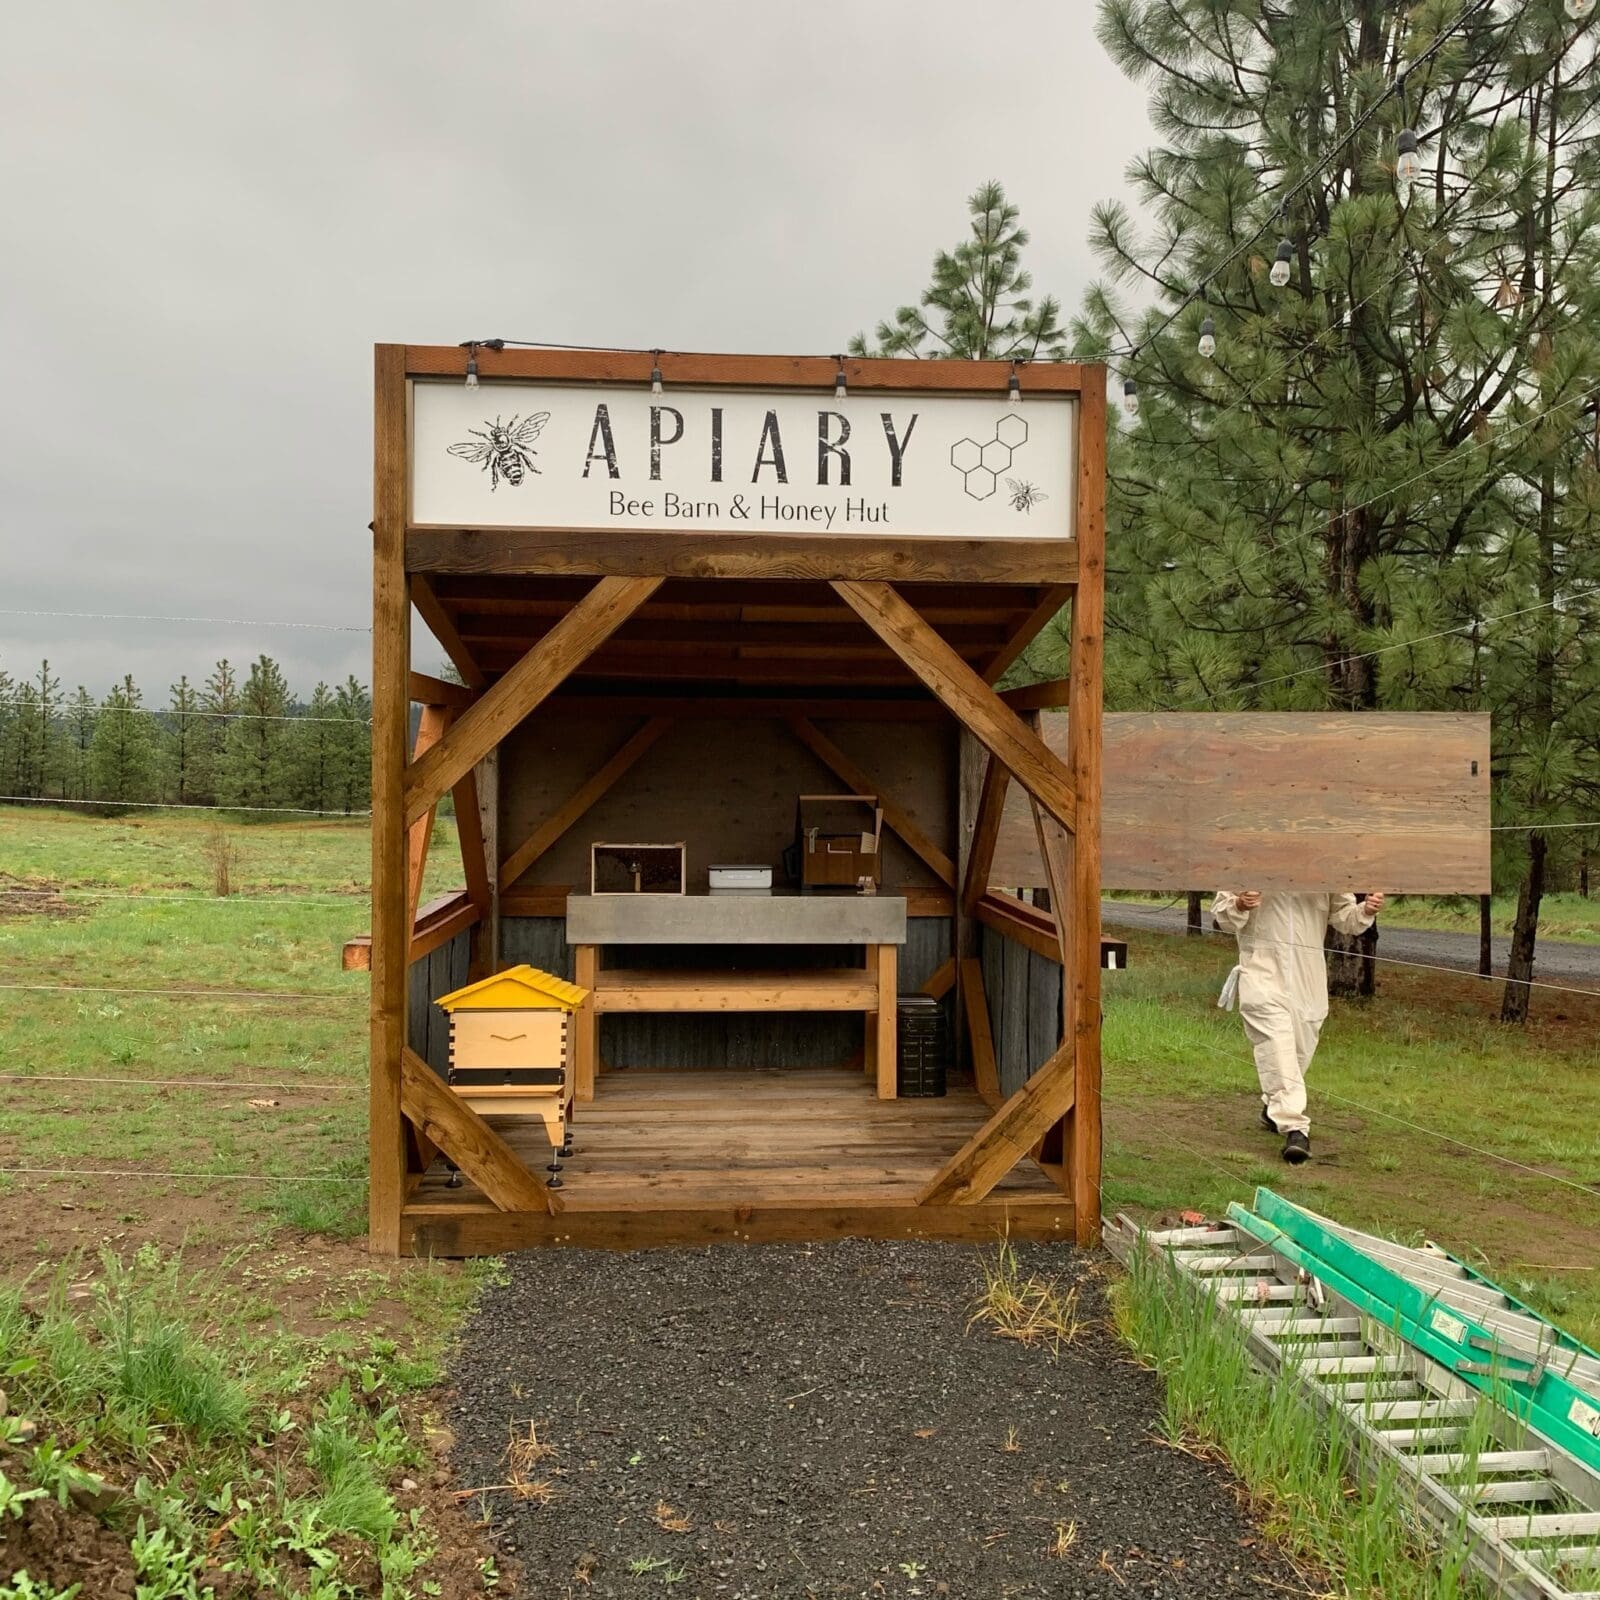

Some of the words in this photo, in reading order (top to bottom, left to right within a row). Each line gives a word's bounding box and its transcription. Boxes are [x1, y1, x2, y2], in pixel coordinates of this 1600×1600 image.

[582, 403, 919, 487] APIARY
[609, 490, 655, 517] Bee
[664, 492, 721, 519] Barn
[729, 494, 752, 520] &
[760, 495, 838, 530] Honey
[846, 497, 891, 523] Hut
